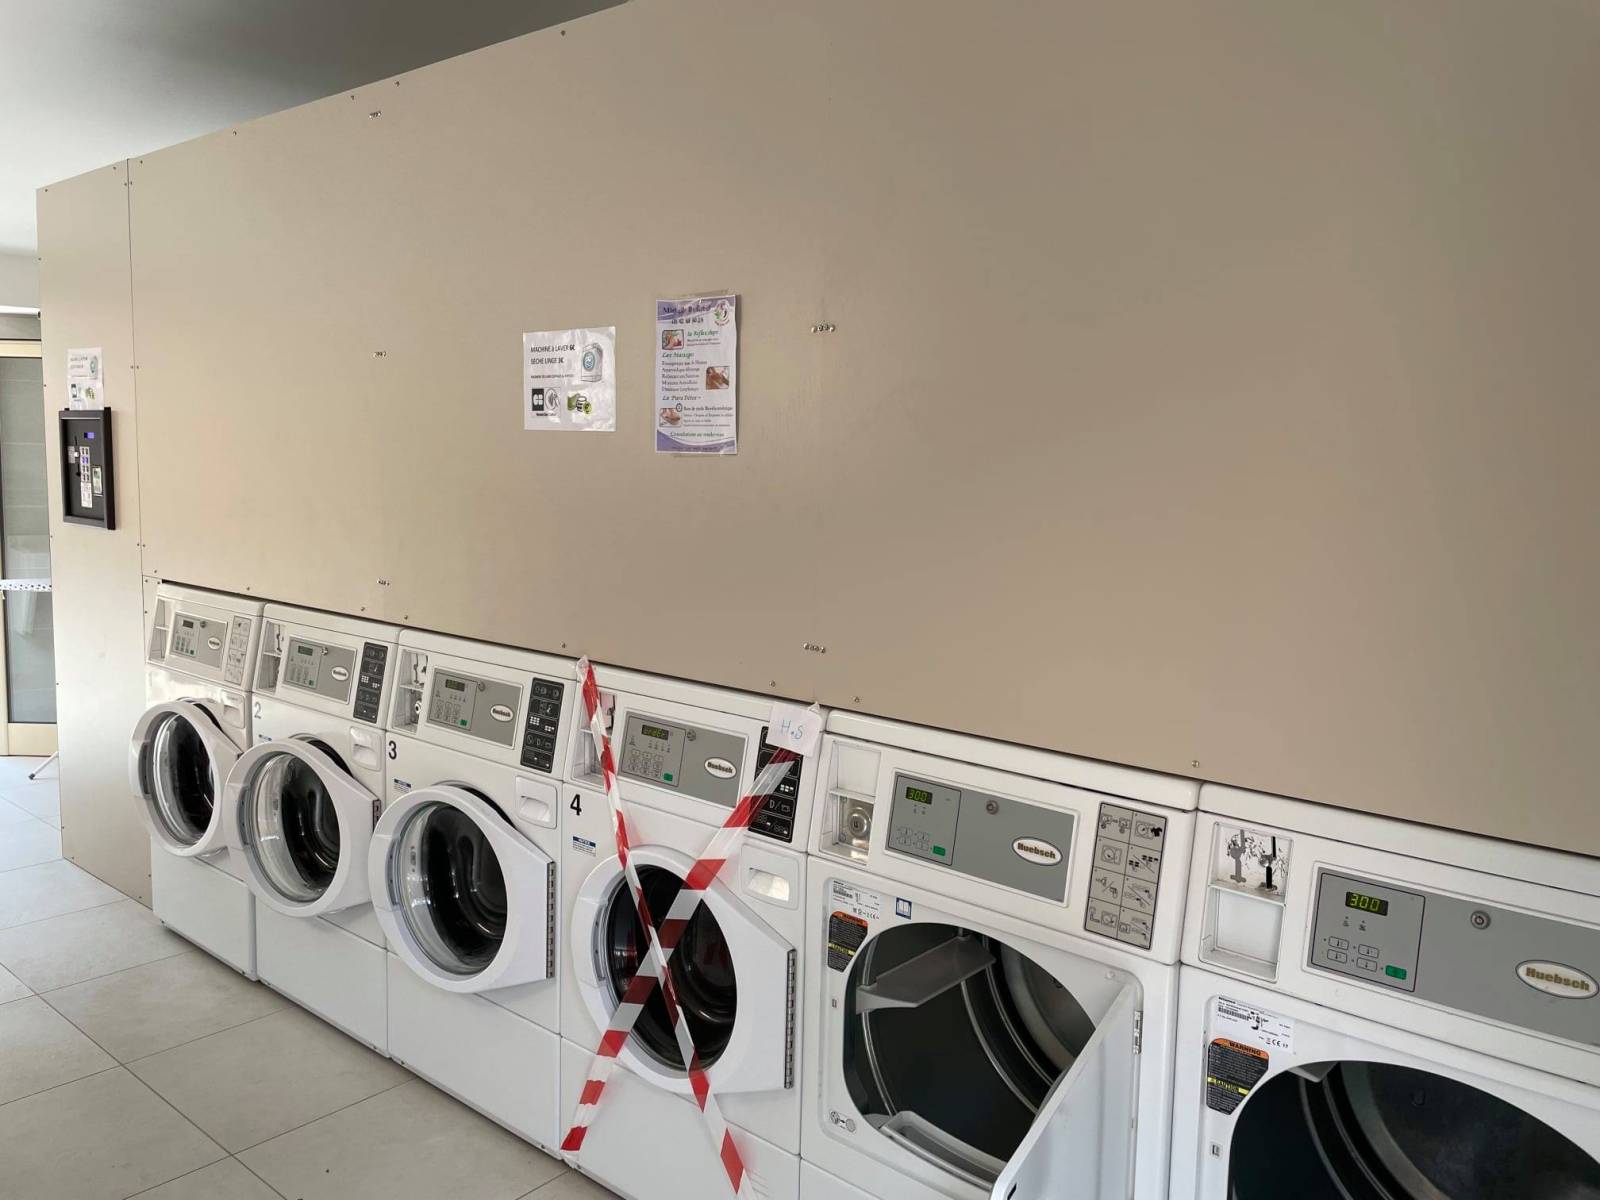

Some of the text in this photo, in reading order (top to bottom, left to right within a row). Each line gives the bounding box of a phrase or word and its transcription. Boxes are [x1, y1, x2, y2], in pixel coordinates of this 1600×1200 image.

[254, 701, 262, 719] 2
[388, 740, 397, 760] 3
[570, 793, 582, 816] 4
[909, 789, 928, 802] 300
[1017, 842, 1056, 859] Huebsch
[1349, 893, 1380, 912] 300
[1525, 966, 1590, 992] Huebsch
[1229, 1041, 1261, 1056] WARNING
